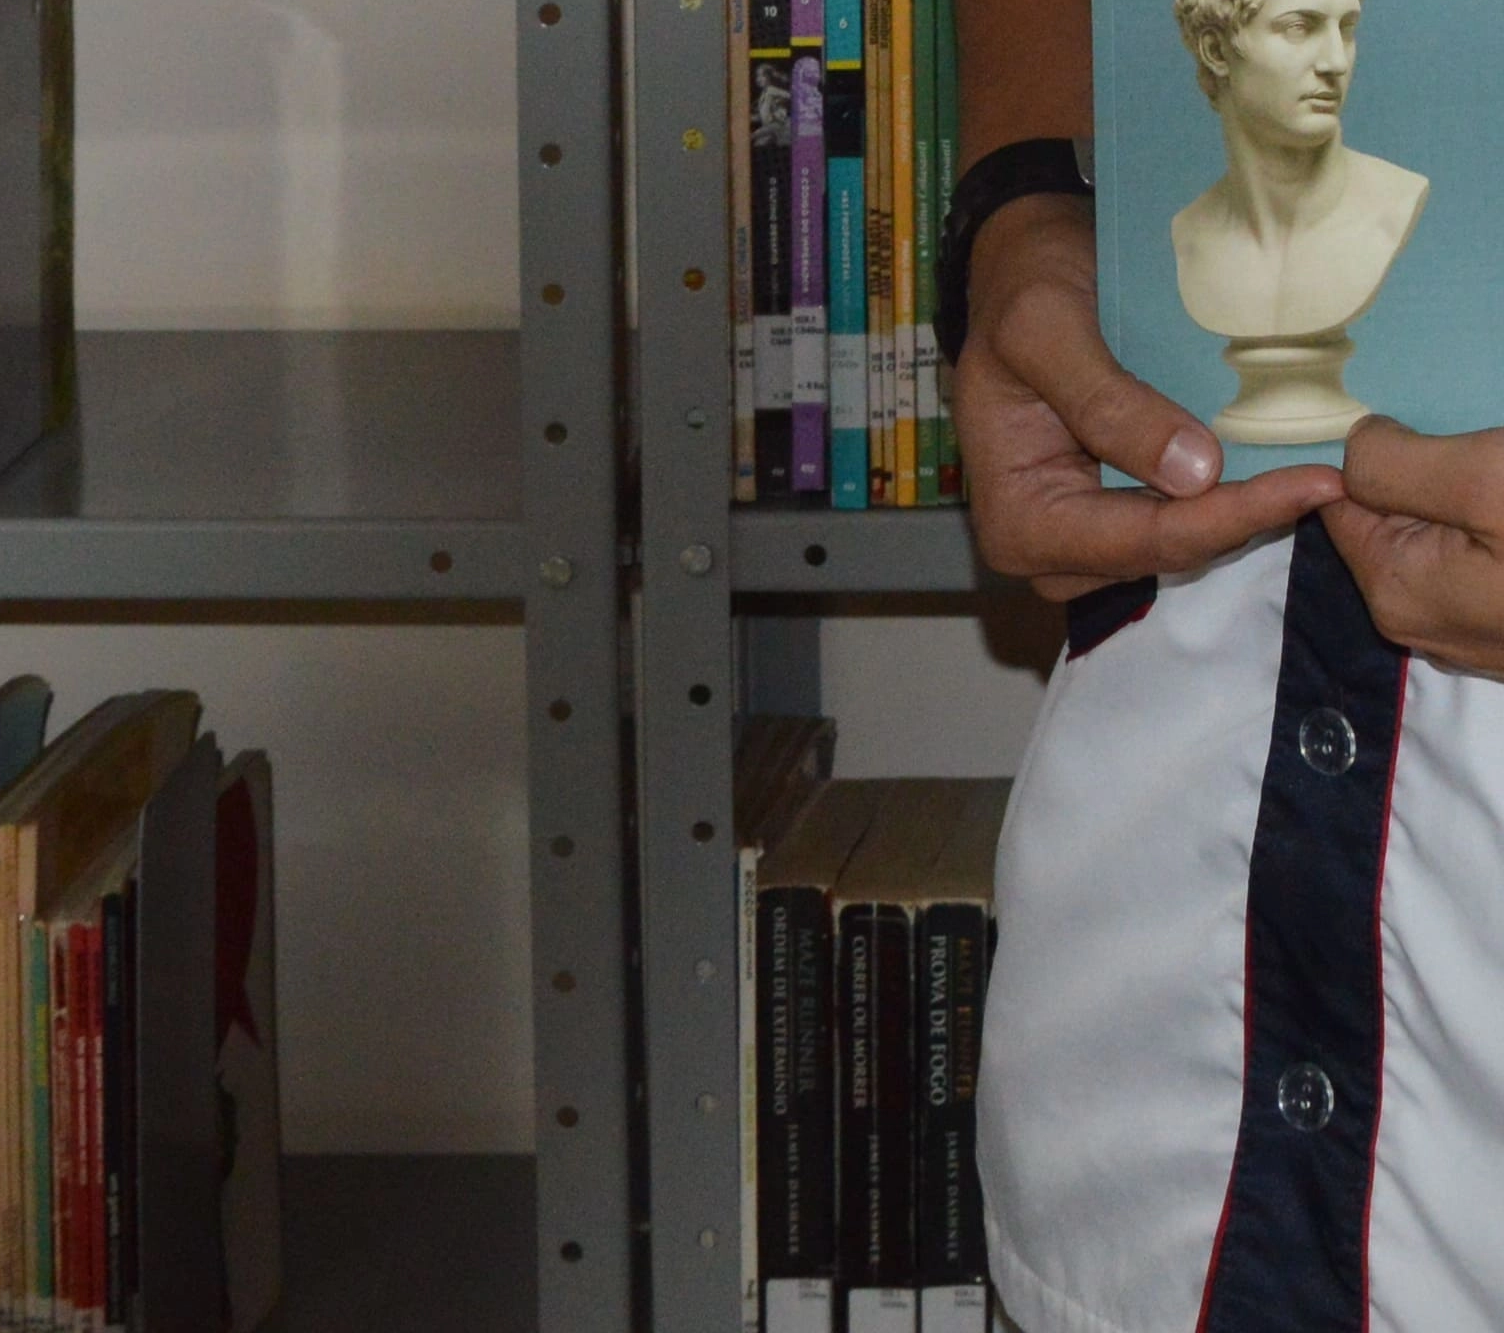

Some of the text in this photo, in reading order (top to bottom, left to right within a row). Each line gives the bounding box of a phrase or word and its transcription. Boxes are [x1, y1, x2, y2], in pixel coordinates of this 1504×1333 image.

[763, 6, 778, 17] 10
[770, 906, 789, 1116] ORDEM DE EXTERMÍNIO
[796, 929, 816, 1093] MAZE RUNNER
[851, 936, 867, 1109] CORRER OU MORRER
[928, 935, 947, 1106] PROVA DE FOGO
[945, 1131, 960, 1261] JAMES DASHNER
